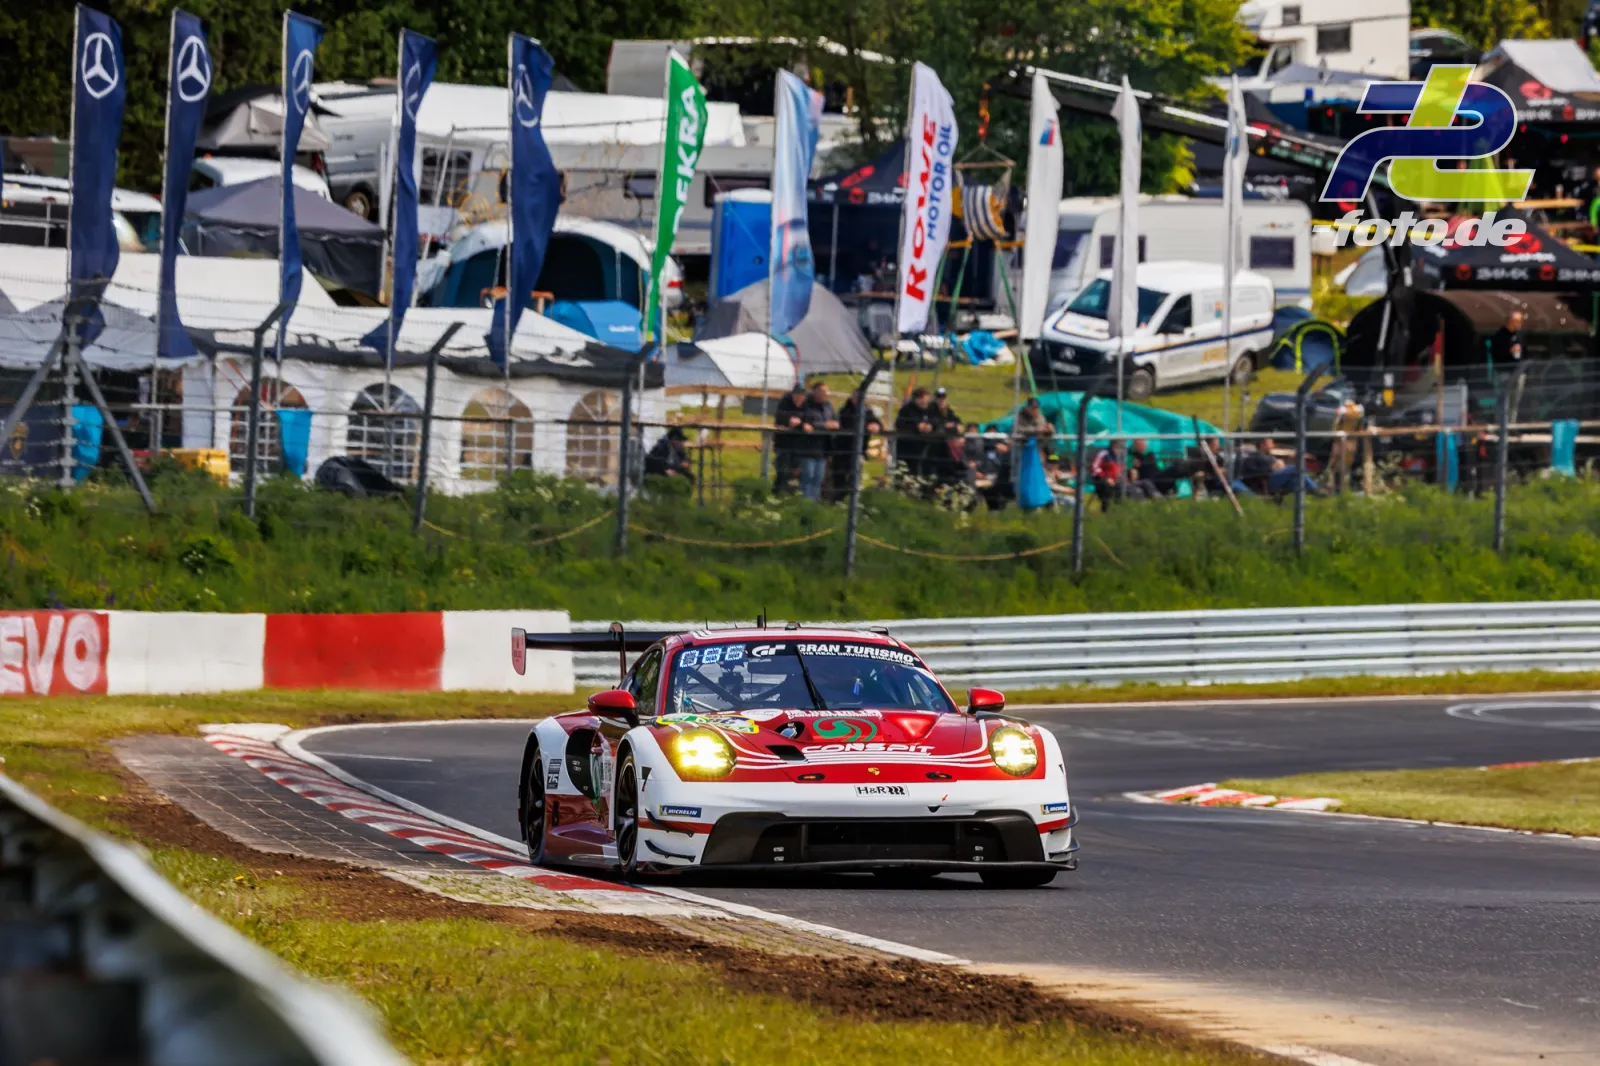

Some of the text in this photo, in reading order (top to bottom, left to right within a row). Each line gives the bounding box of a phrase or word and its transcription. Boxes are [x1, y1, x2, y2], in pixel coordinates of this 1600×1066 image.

[927, 123, 952, 240] MOTOR OIL
[906, 113, 936, 302] ROWE
[797, 644, 914, 663] GRAN TURISMO
[802, 743, 935, 756] CONSPIT
[857, 786, 887, 795] H&R
